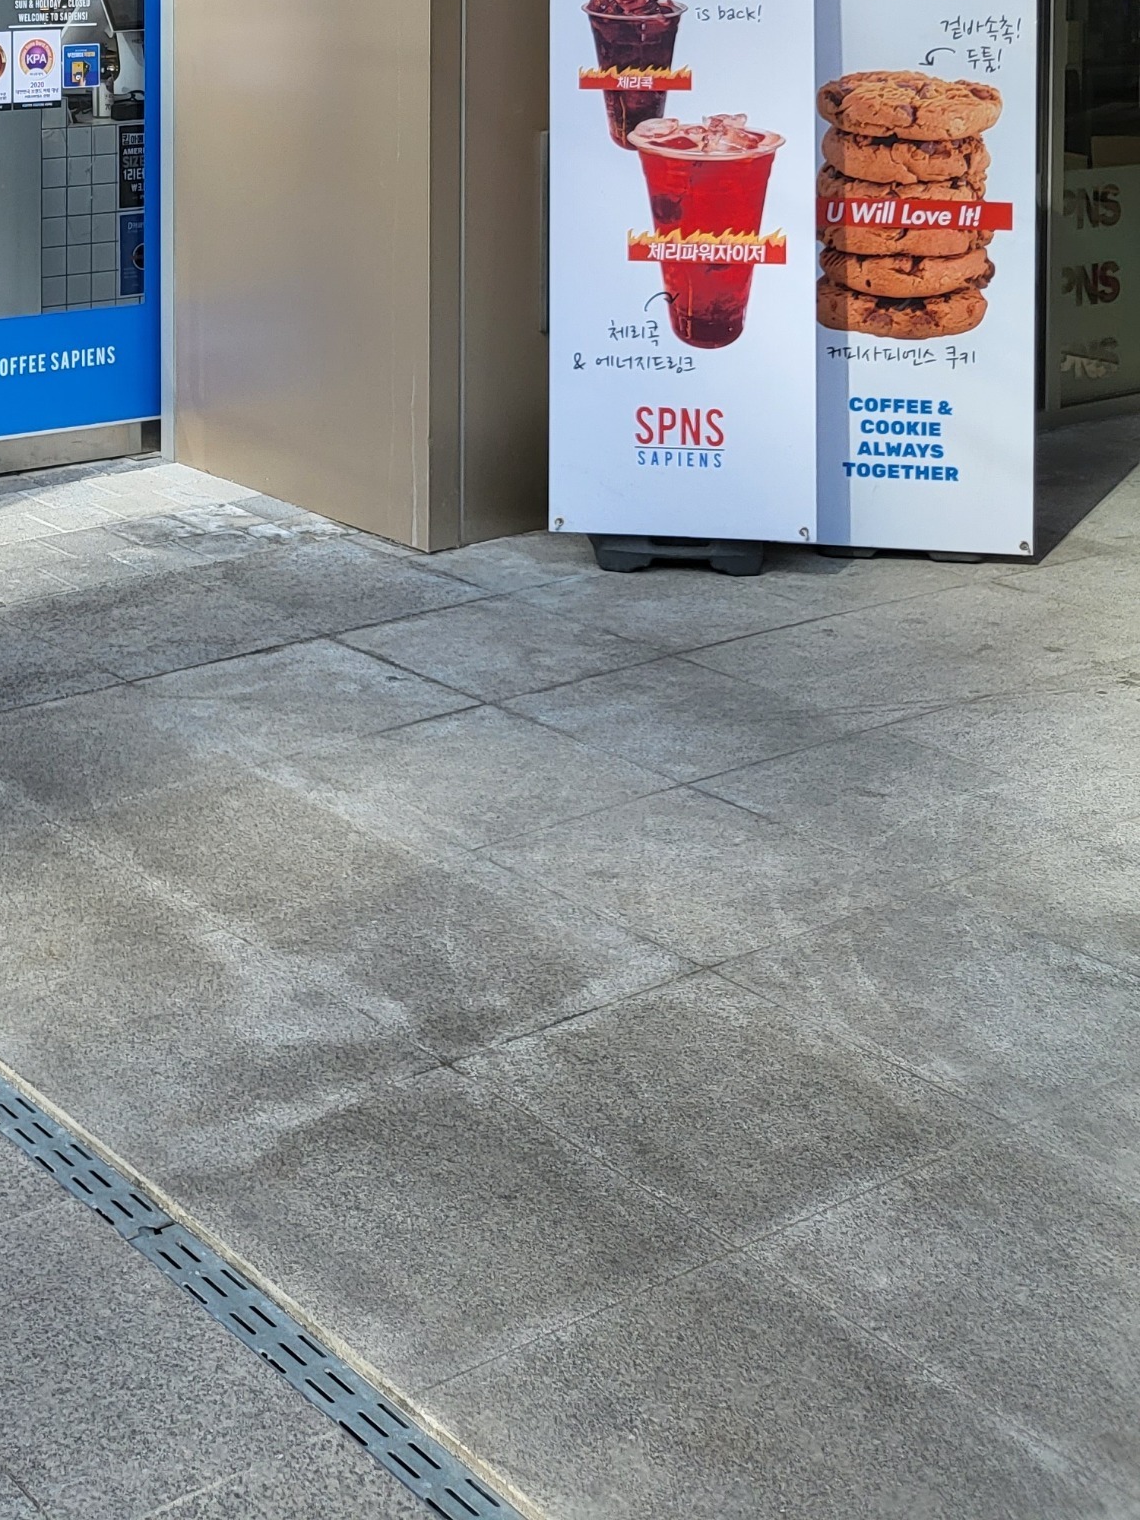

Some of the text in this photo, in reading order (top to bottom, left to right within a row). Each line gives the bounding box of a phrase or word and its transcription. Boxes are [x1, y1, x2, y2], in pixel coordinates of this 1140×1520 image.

[14, 0, 90, 9] SUN & HOLIDAY CLOSED
[695, 5, 762, 22] is back!
[18, 12, 88, 22] WELCOME TO SAPIENS!
[940, 15, 1021, 45] 겉바속촉!
[26, 54, 47, 64] KPA
[616, 76, 653, 90] 체리콕
[826, 201, 981, 227] U Will Love It!
[647, 243, 766, 262] 체리파워자이저
[608, 320, 660, 347] 체리콕
[50, 346, 116, 371] SAPIENS
[573, 352, 696, 374] & 에너지드링크
[826, 345, 976, 369] 커피사피엔스 쿠키
[849, 397, 953, 416] COFFEE &
[635, 406, 724, 447] SPNS
[860, 419, 941, 437] COOKIE
[637, 450, 722, 468] SAPIENS
[857, 441, 944, 459] ALWAYS
[842, 462, 959, 482] TOGETHER
